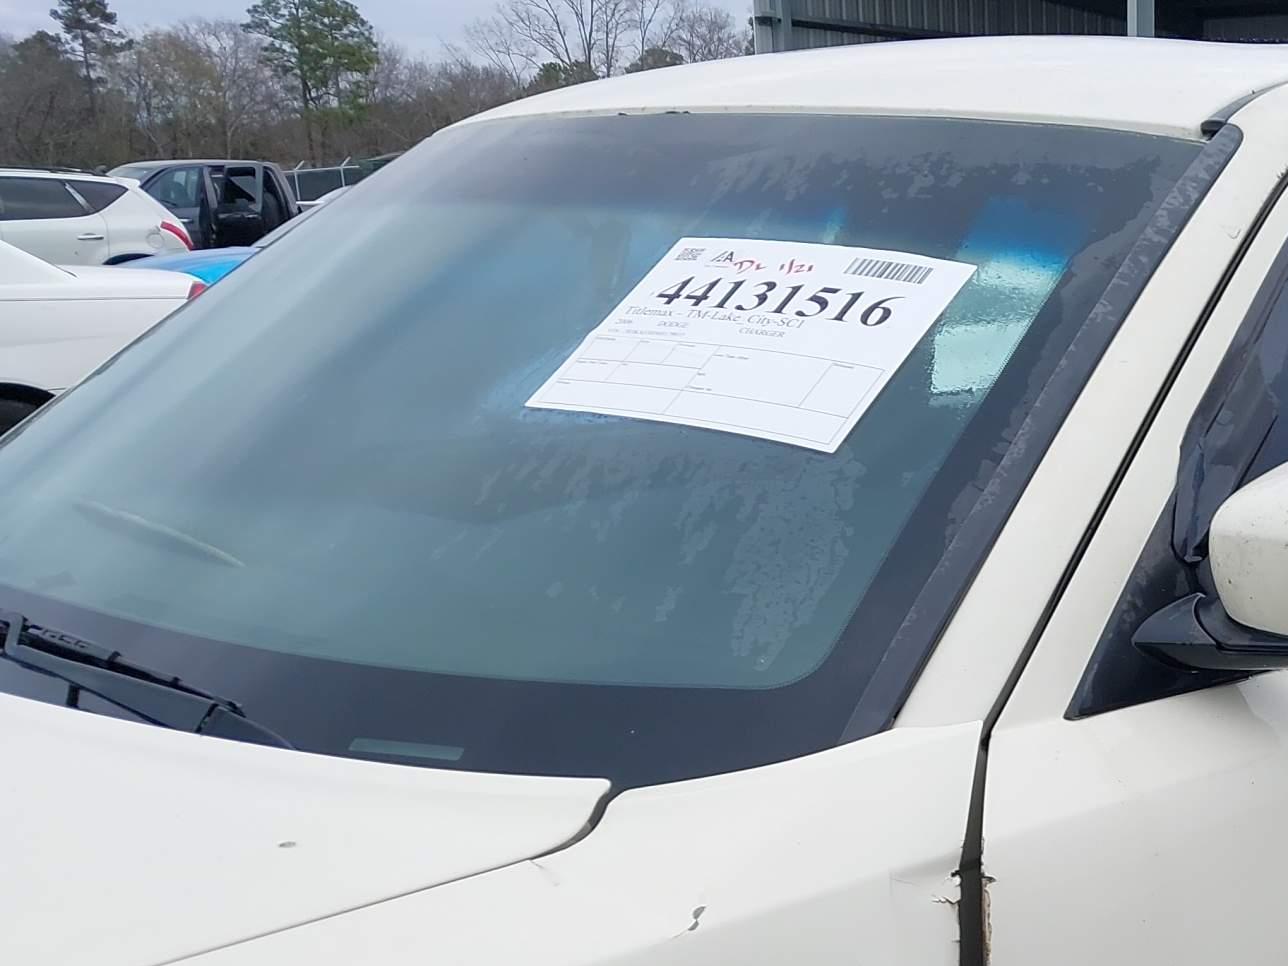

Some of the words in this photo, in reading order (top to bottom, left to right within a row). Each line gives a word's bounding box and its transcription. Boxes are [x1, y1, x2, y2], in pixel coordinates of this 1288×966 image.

[656, 276, 905, 327] 44131516
[625, 306, 673, 317] Titlemax
[739, 327, 786, 338] CHARGER
